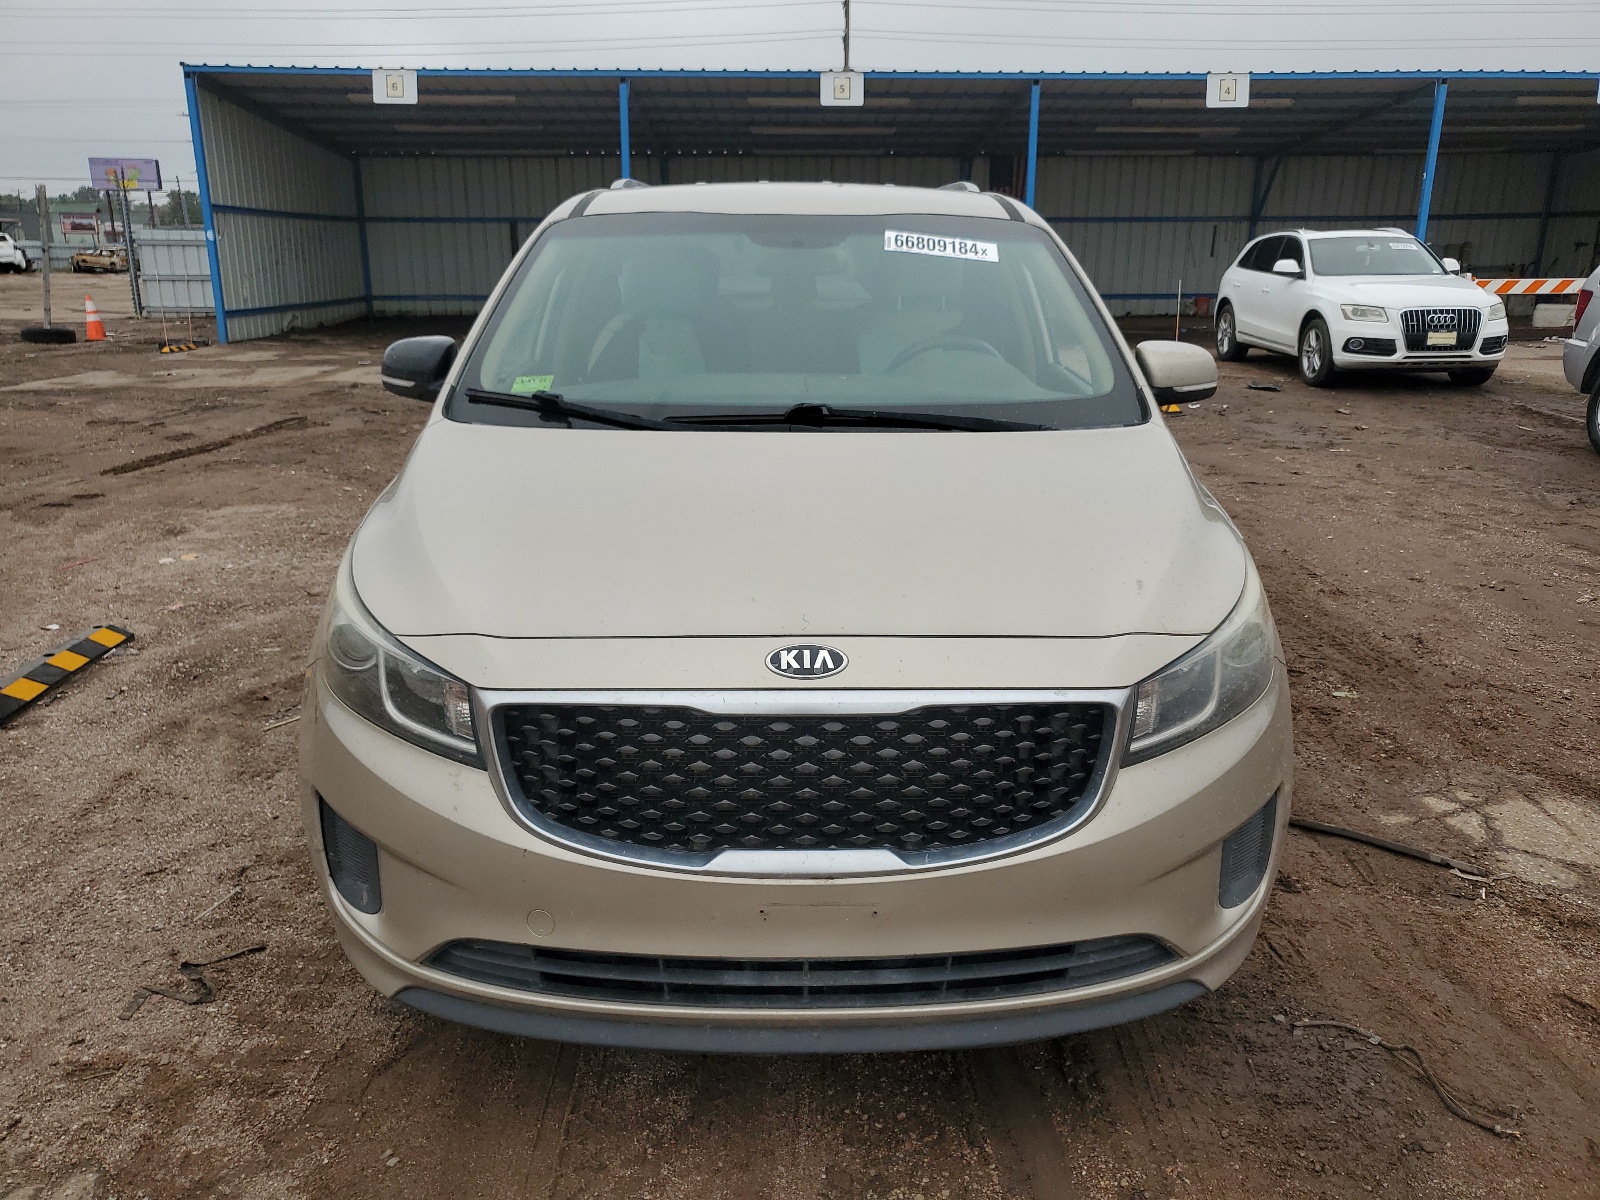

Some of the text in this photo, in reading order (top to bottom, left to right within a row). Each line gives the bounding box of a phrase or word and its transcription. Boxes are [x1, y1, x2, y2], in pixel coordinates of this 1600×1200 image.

[391, 82, 398, 92] 6
[839, 84, 845, 94] 5
[1224, 86, 1231, 96] 4
[779, 649, 835, 670] KIA
